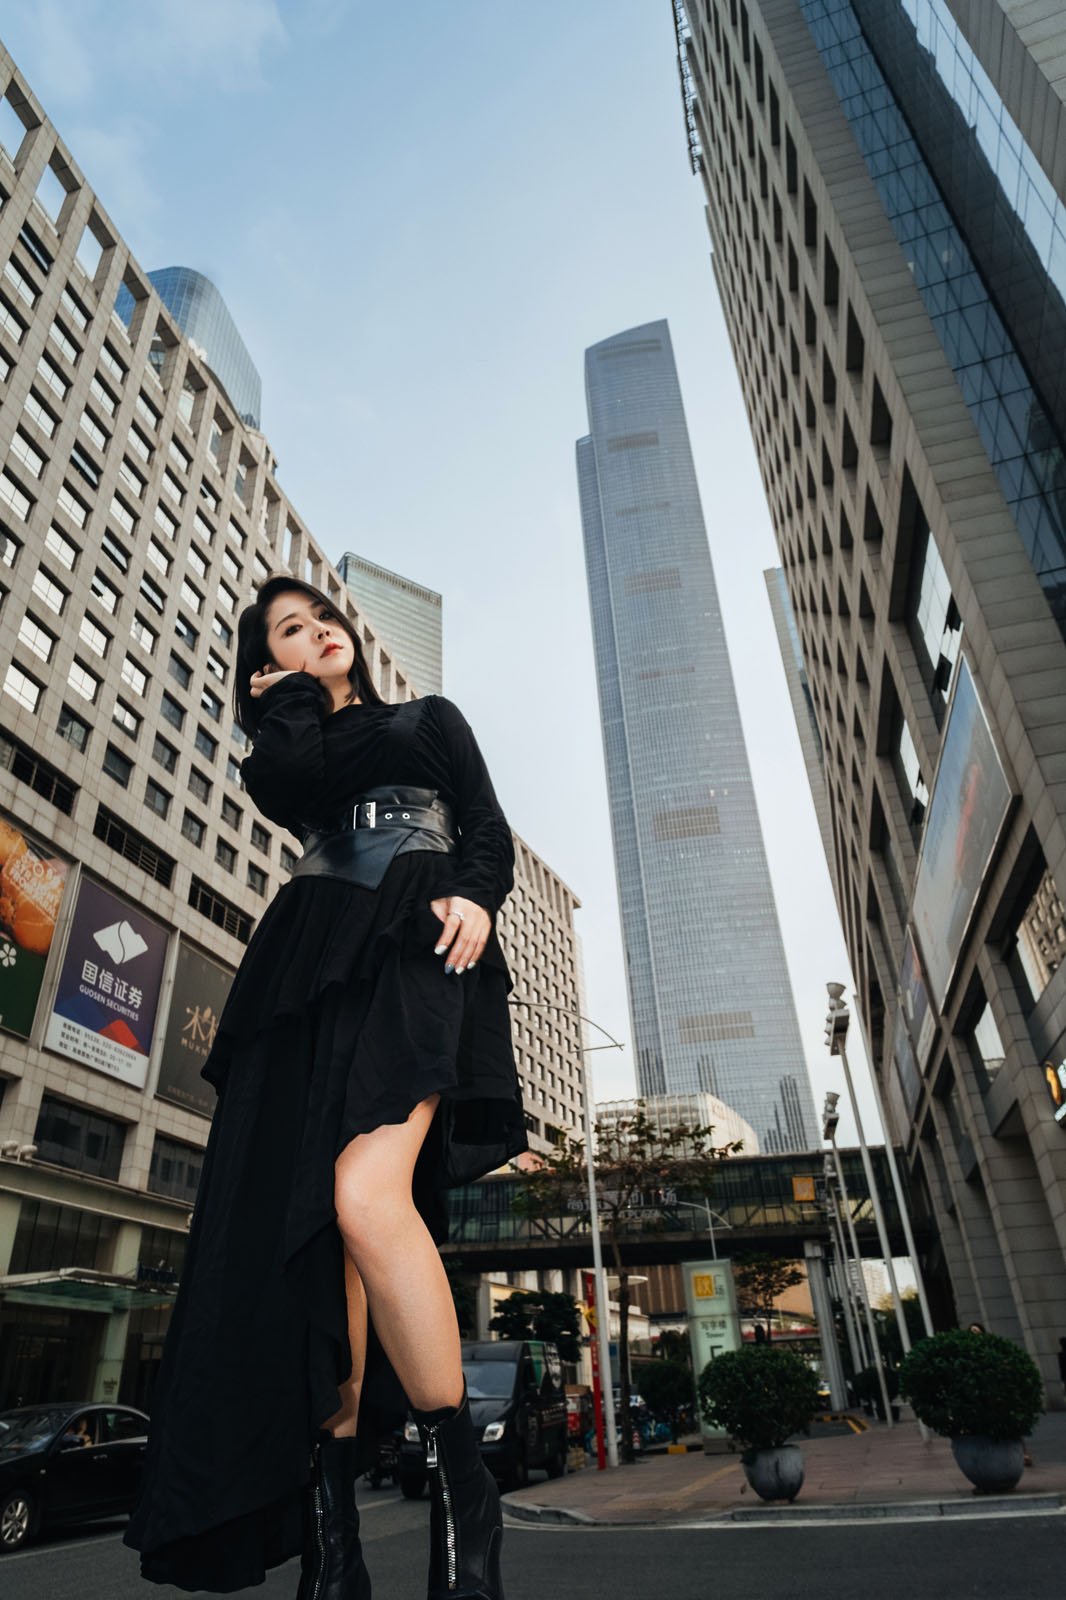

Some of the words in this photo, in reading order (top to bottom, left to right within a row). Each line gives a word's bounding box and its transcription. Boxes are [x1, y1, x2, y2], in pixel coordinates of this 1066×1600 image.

[79, 984, 106, 1004] GUOSEN
[106, 998, 140, 1021] SECURITIES
[81, 960, 143, 1009] 国信证券
